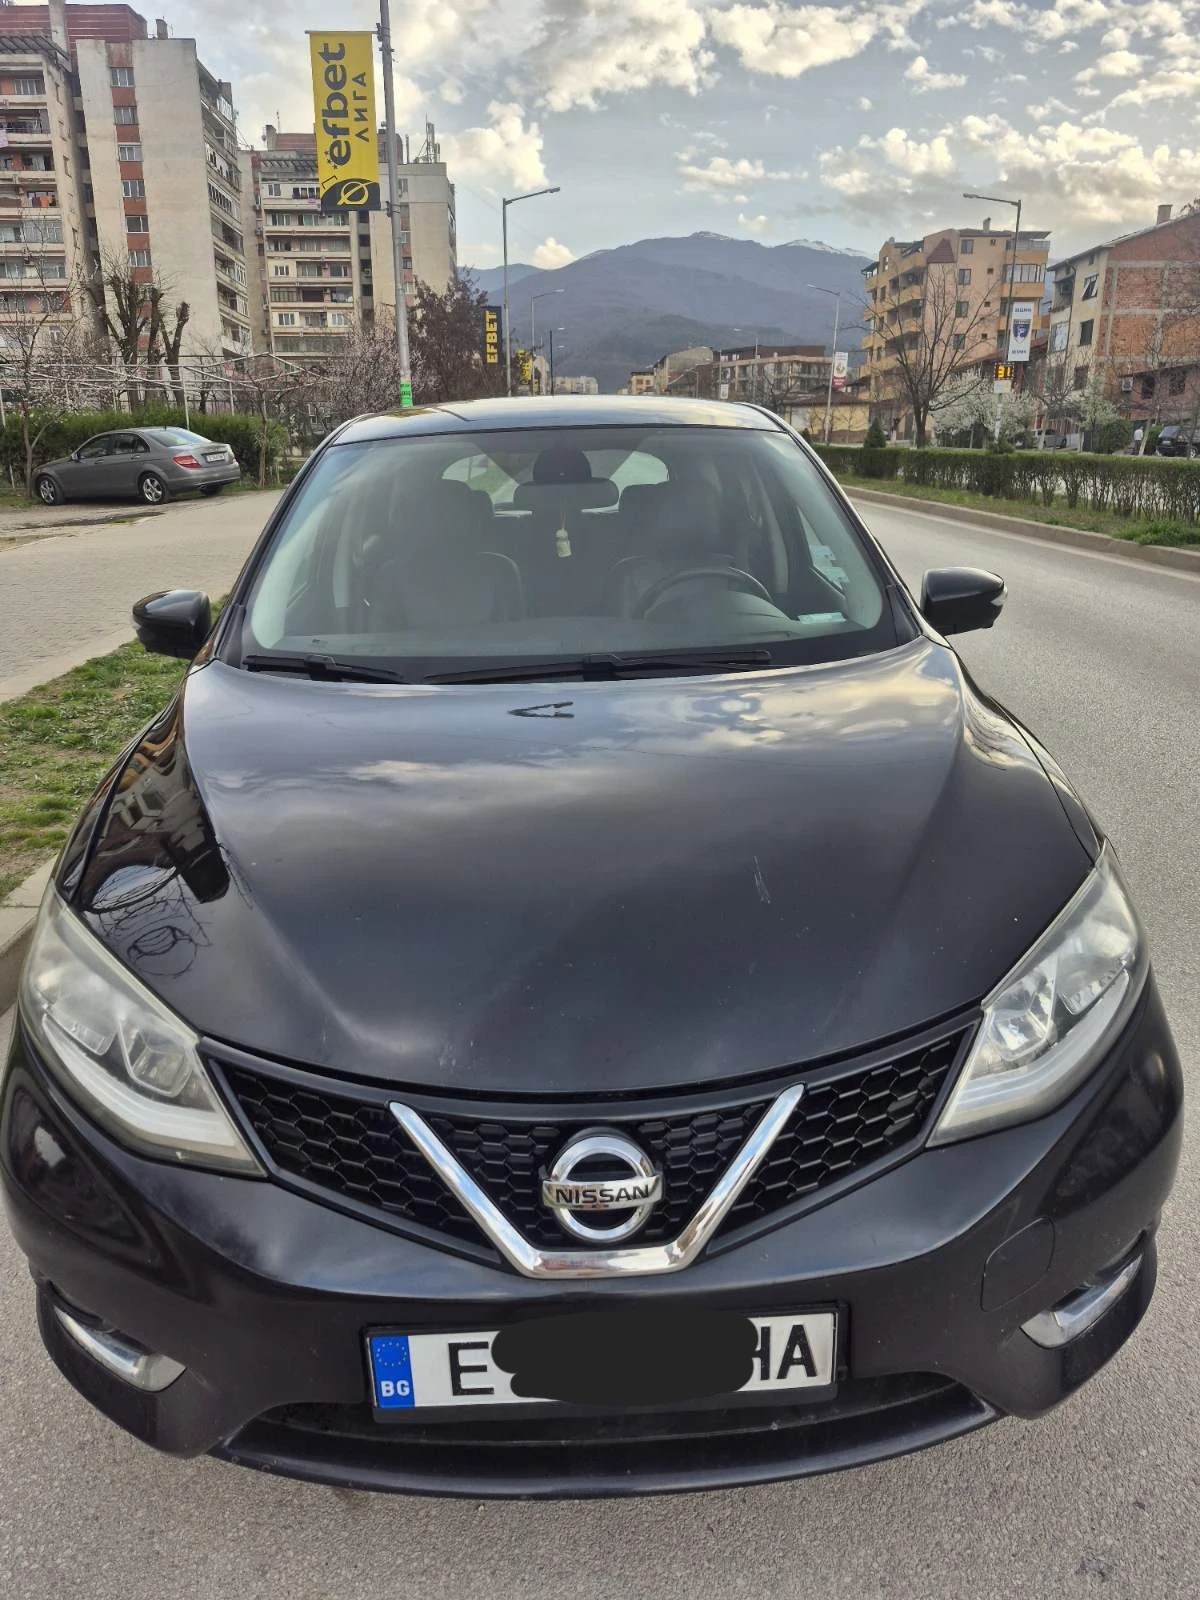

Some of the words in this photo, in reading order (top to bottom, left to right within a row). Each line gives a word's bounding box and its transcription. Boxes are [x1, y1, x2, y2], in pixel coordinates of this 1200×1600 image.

[318, 42, 351, 166] efbet
[352, 71, 370, 143] ЛИГА
[485, 310, 498, 364] EFBET
[555, 1183, 650, 1206] NISSAN
[380, 1380, 410, 1397] BG
[448, 1341, 495, 1396] E
